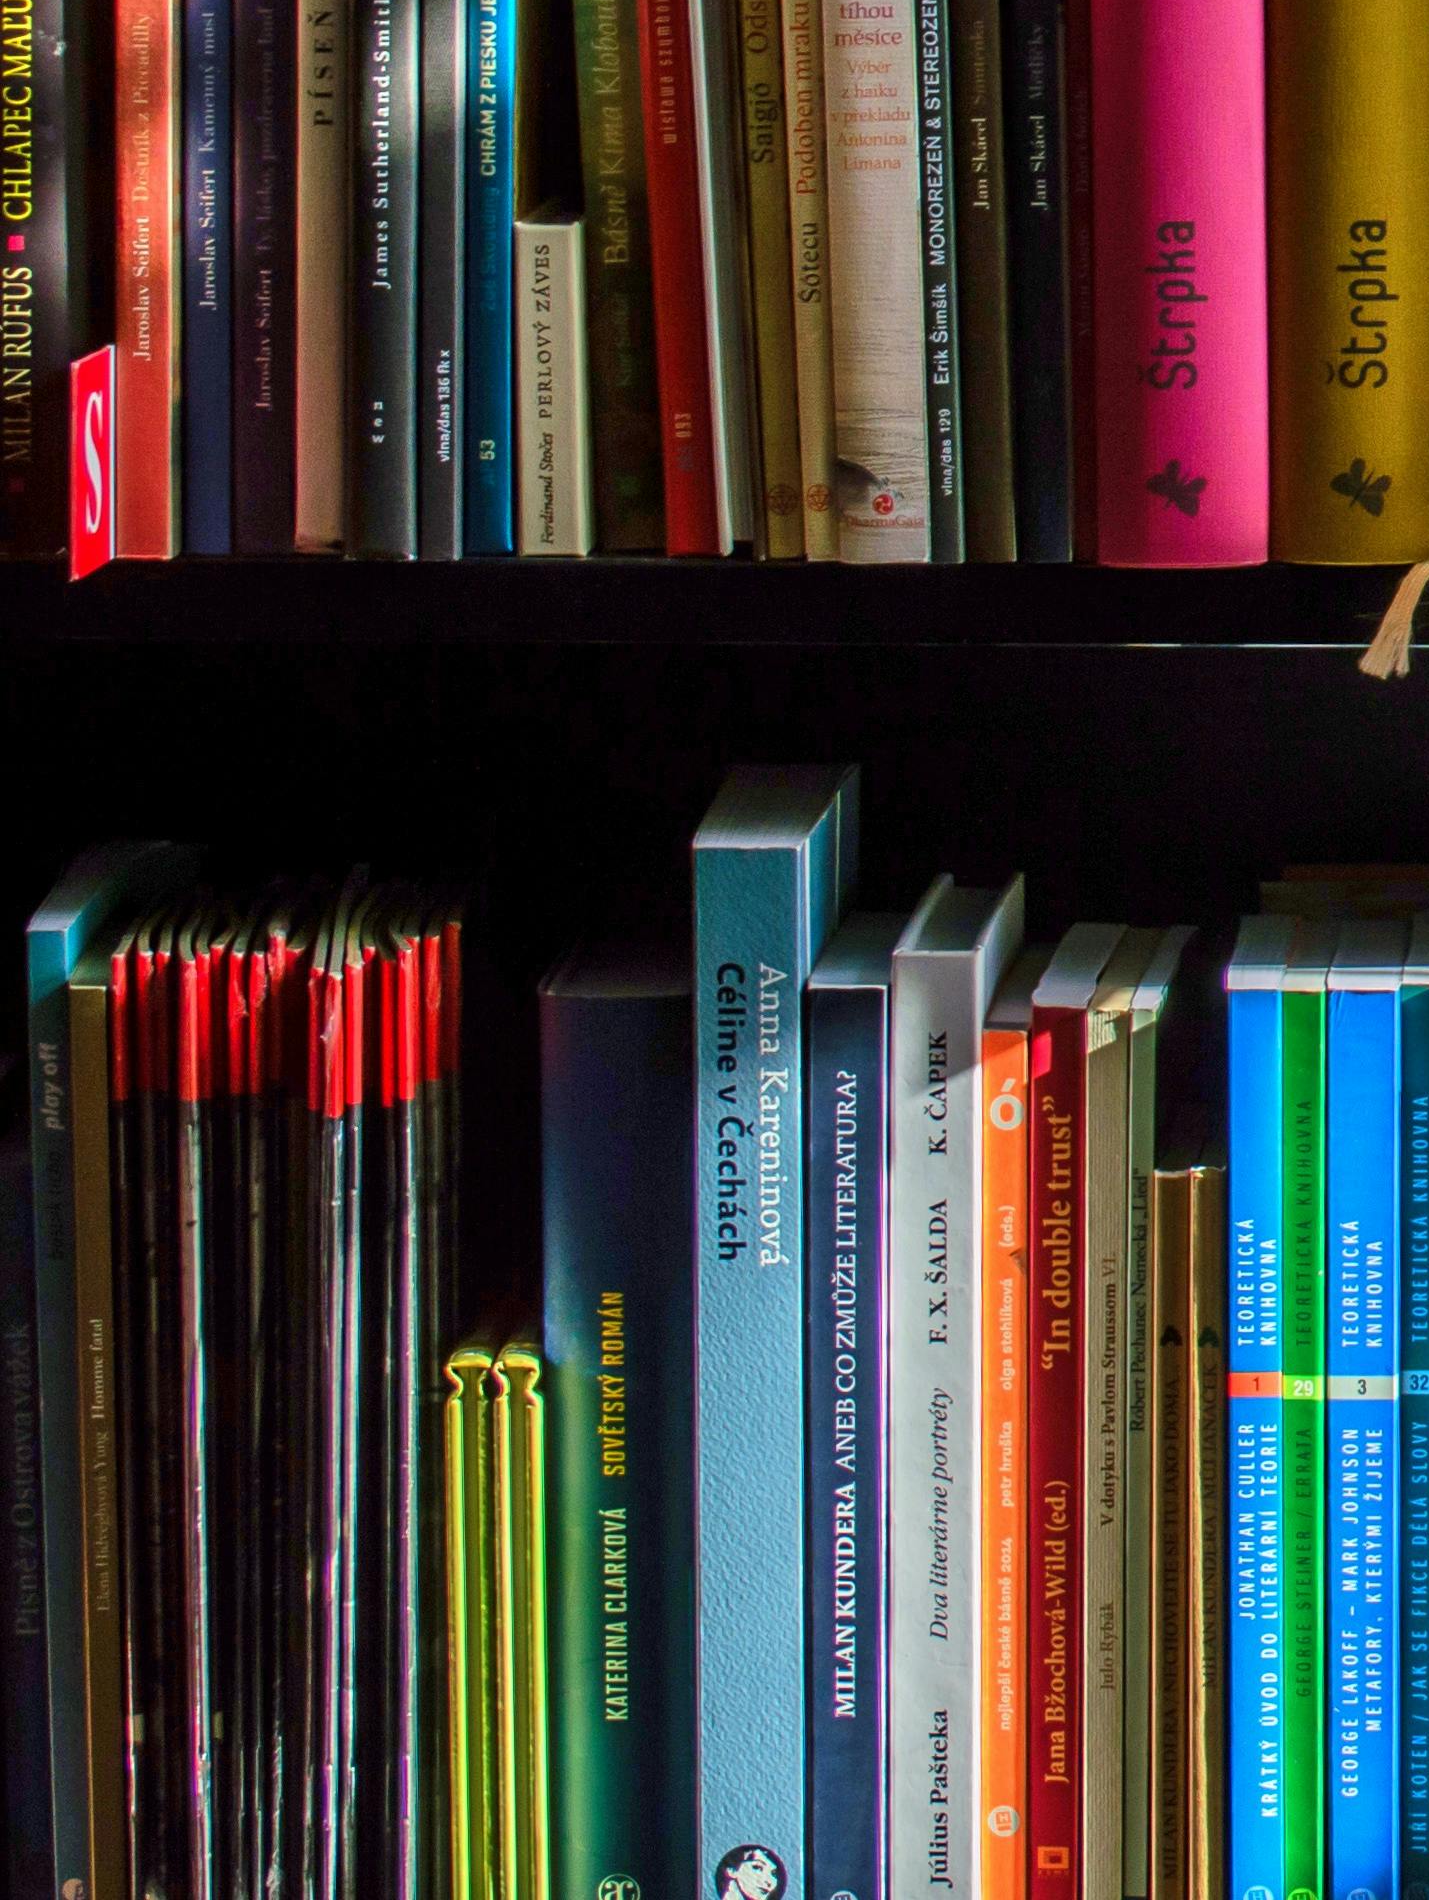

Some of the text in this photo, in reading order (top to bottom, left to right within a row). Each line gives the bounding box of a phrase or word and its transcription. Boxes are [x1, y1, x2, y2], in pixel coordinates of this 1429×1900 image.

[371, 217, 396, 289] James
[932, 349, 950, 385] Erik
[1041, 1200, 1074, 1307] double
[828, 1069, 859, 1717] MILAN KUNDERA ANEB CO ZMŮŽE LITERATURA?
[597, 1291, 631, 1720] KATERINA CLARKOVÁ SOVĚTSKÝ ROMÁN
